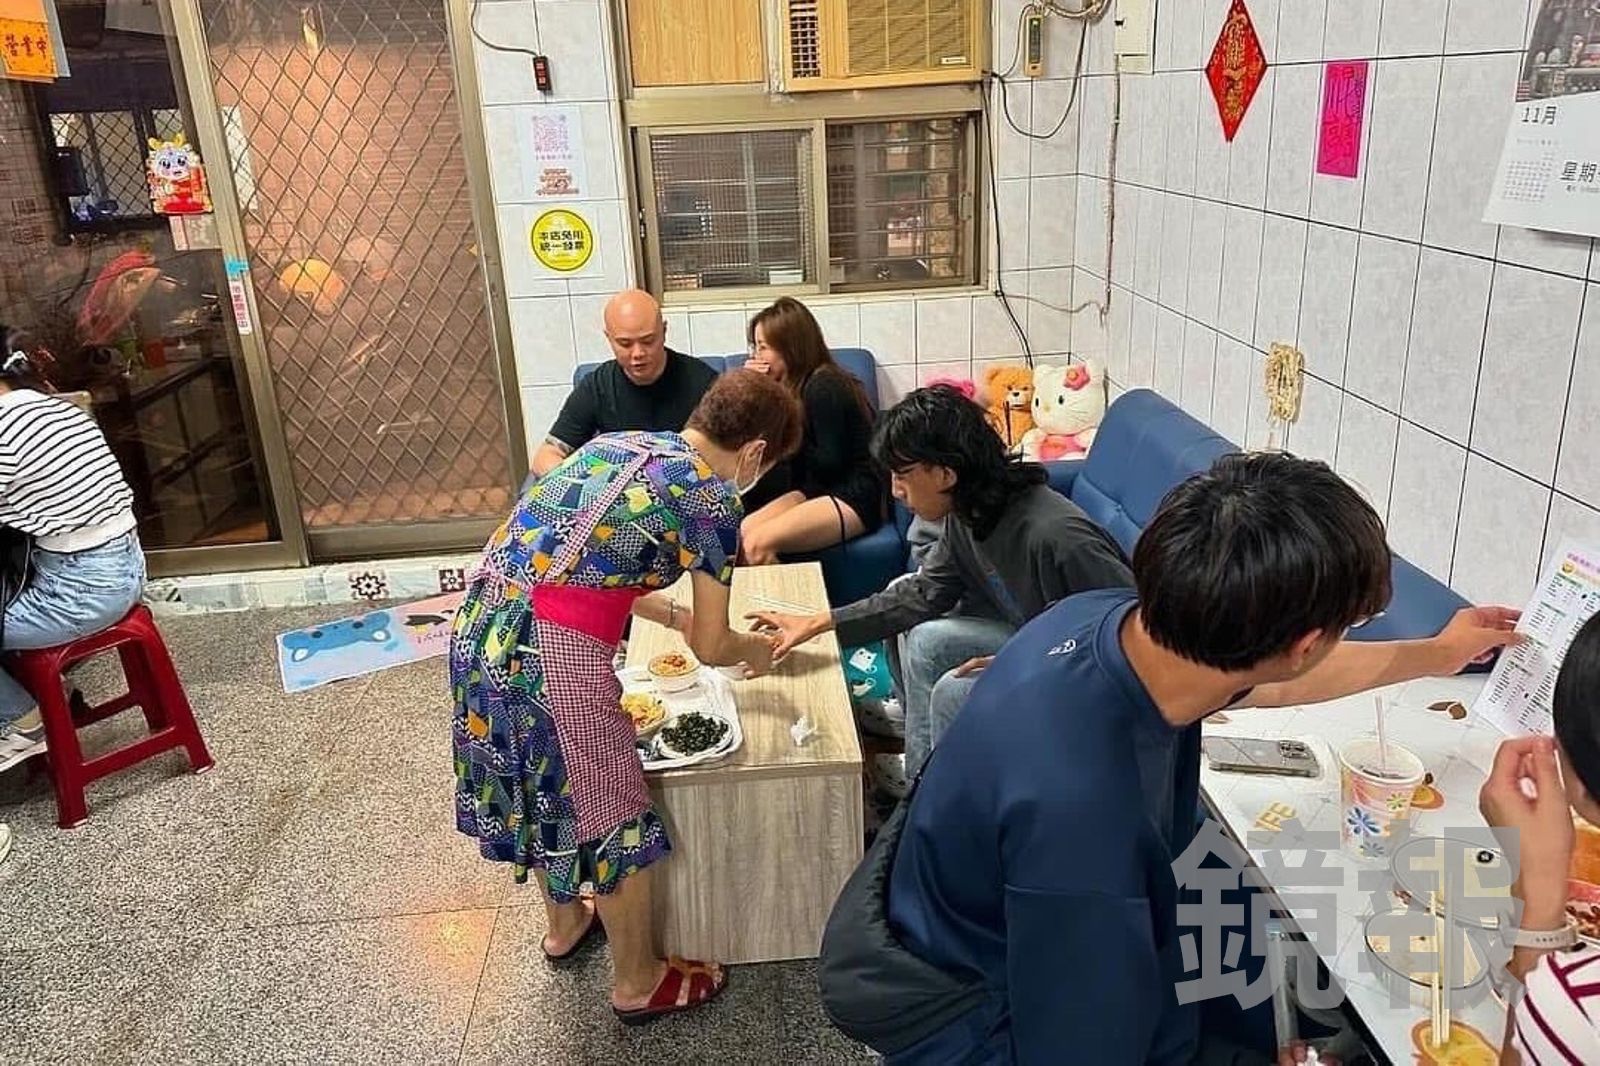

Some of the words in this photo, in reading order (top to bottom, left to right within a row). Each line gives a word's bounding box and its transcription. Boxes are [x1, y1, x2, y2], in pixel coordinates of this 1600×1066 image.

[1521, 106, 1557, 125] 11月
[1560, 161, 1600, 183] 星期
[538, 230, 584, 240] 本店免用
[540, 241, 584, 251] 統一發票
